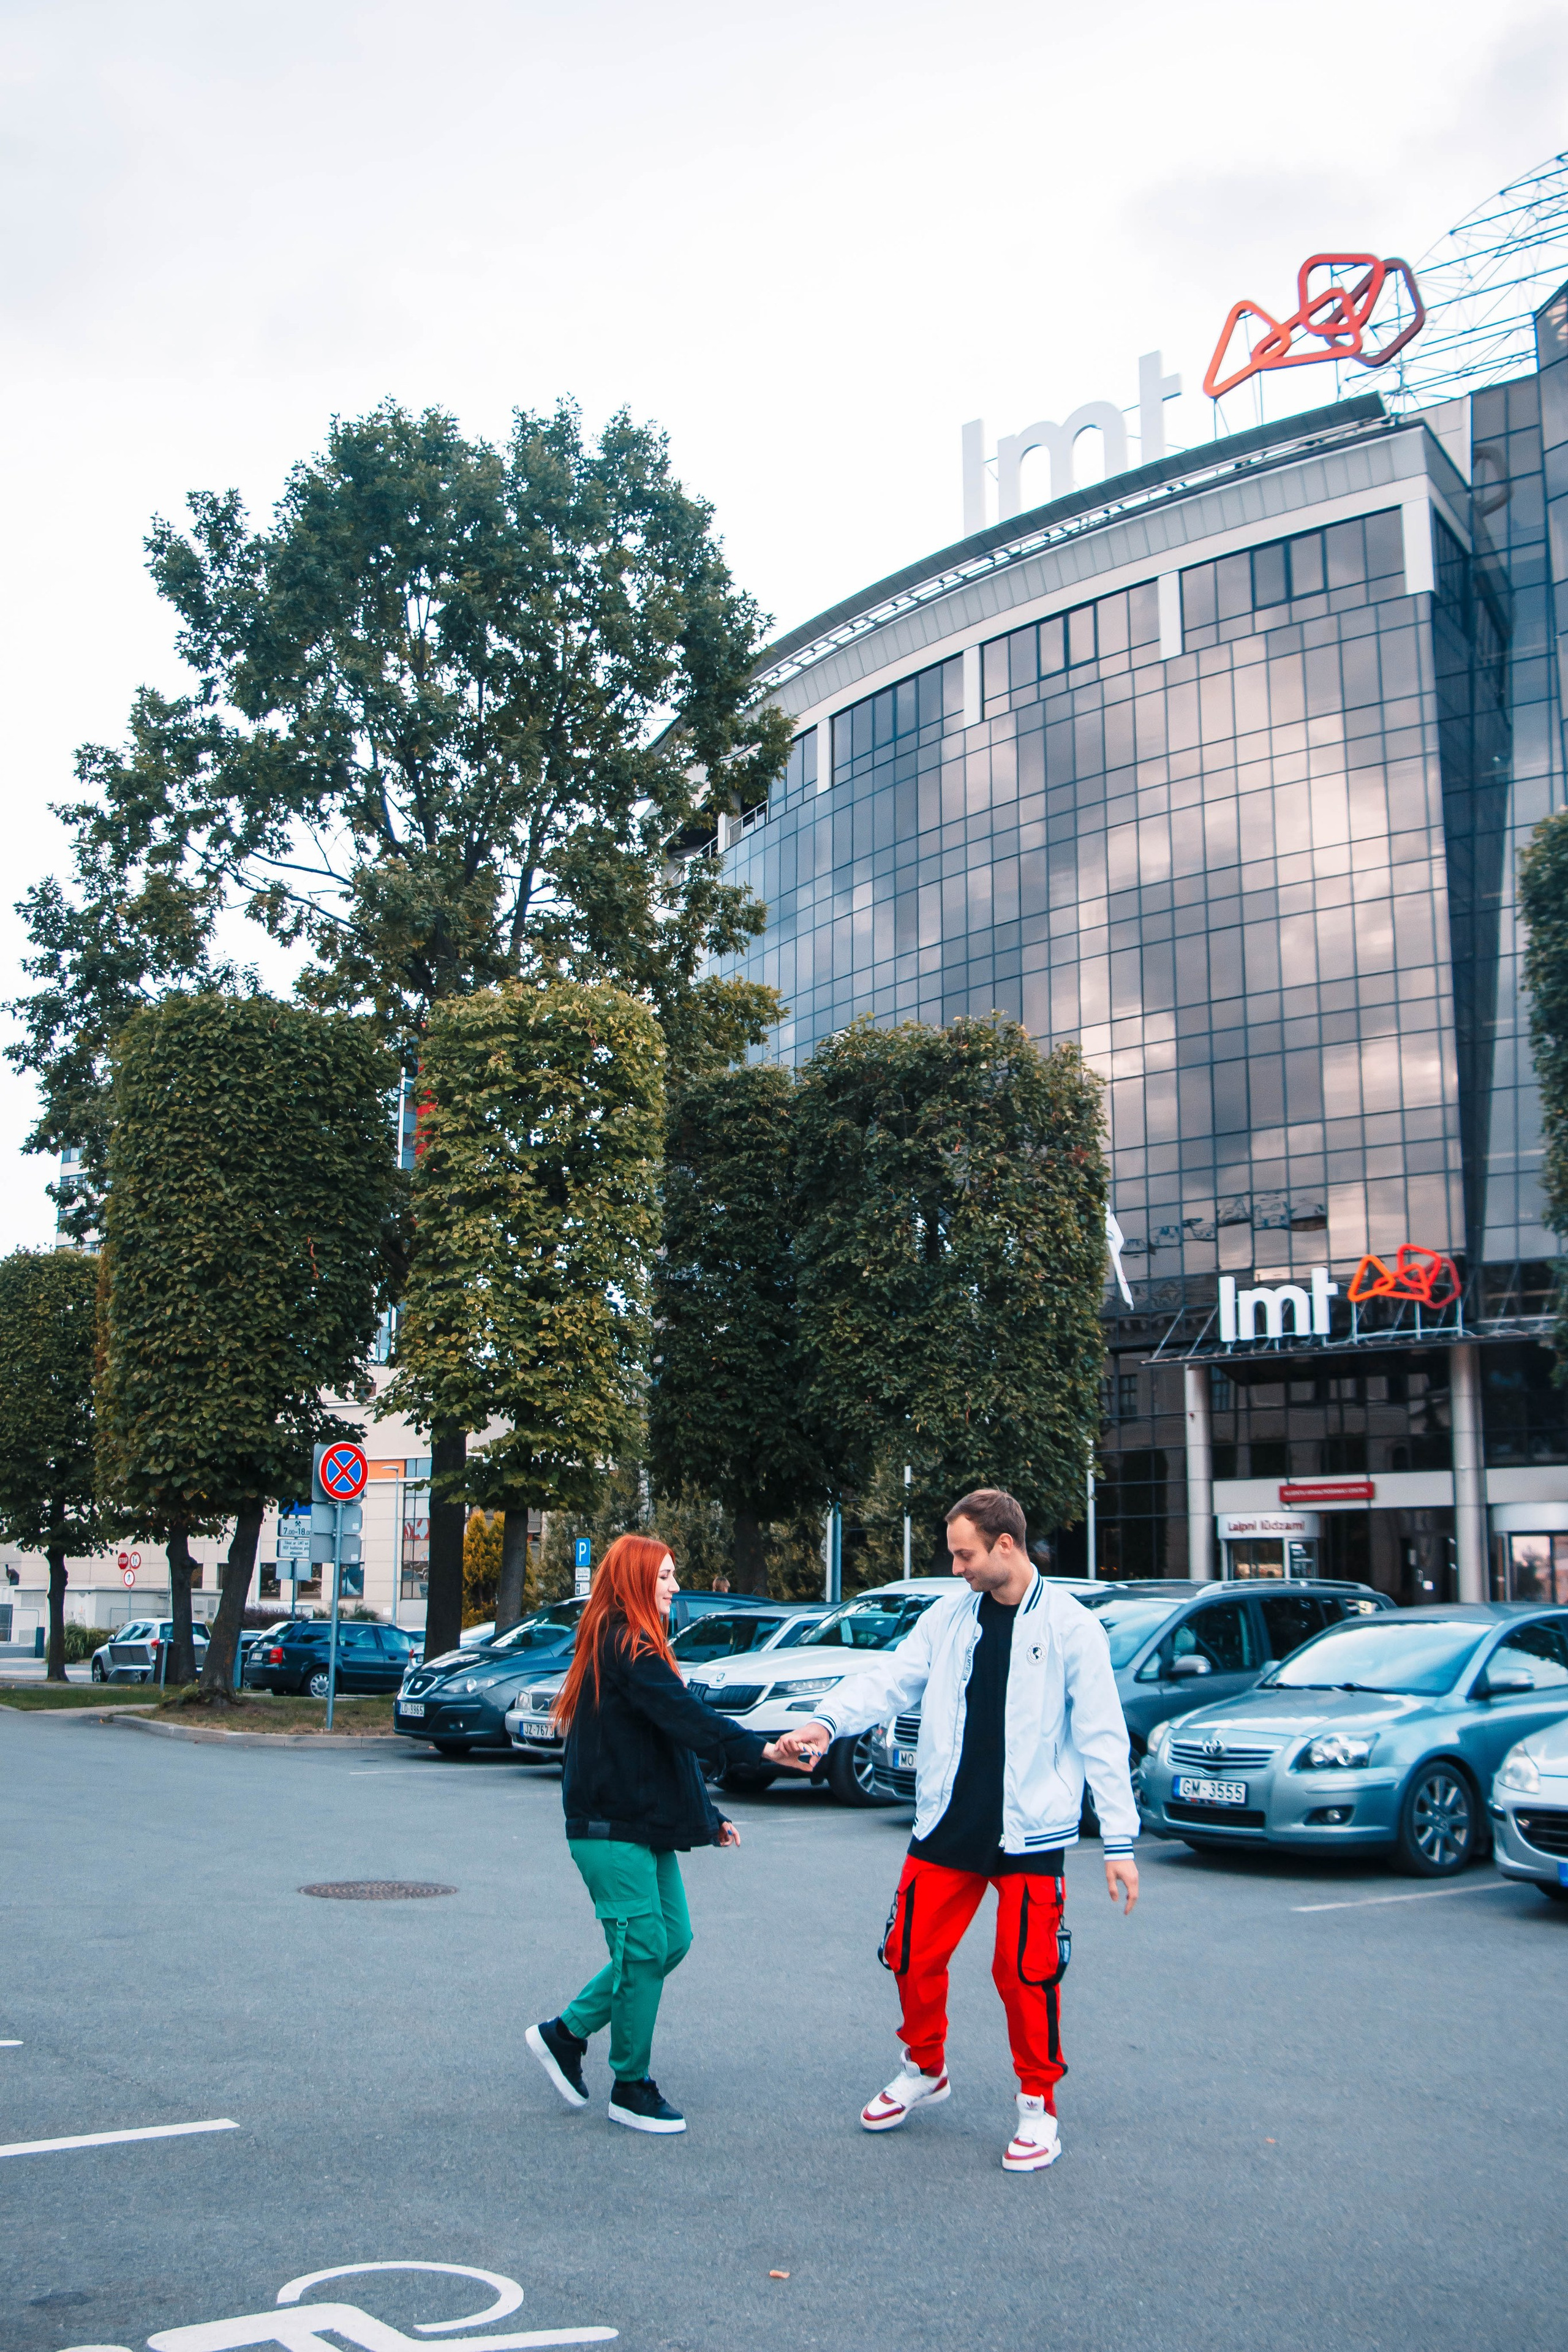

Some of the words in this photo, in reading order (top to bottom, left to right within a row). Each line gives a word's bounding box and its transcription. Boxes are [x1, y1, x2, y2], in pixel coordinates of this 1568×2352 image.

[961, 349, 1183, 538] lmt
[1218, 1267, 1339, 1343] lmt
[579, 1542, 587, 1562] P
[401, 1703, 423, 1716] LO-9965
[1182, 1779, 1243, 1801] GM-3555
